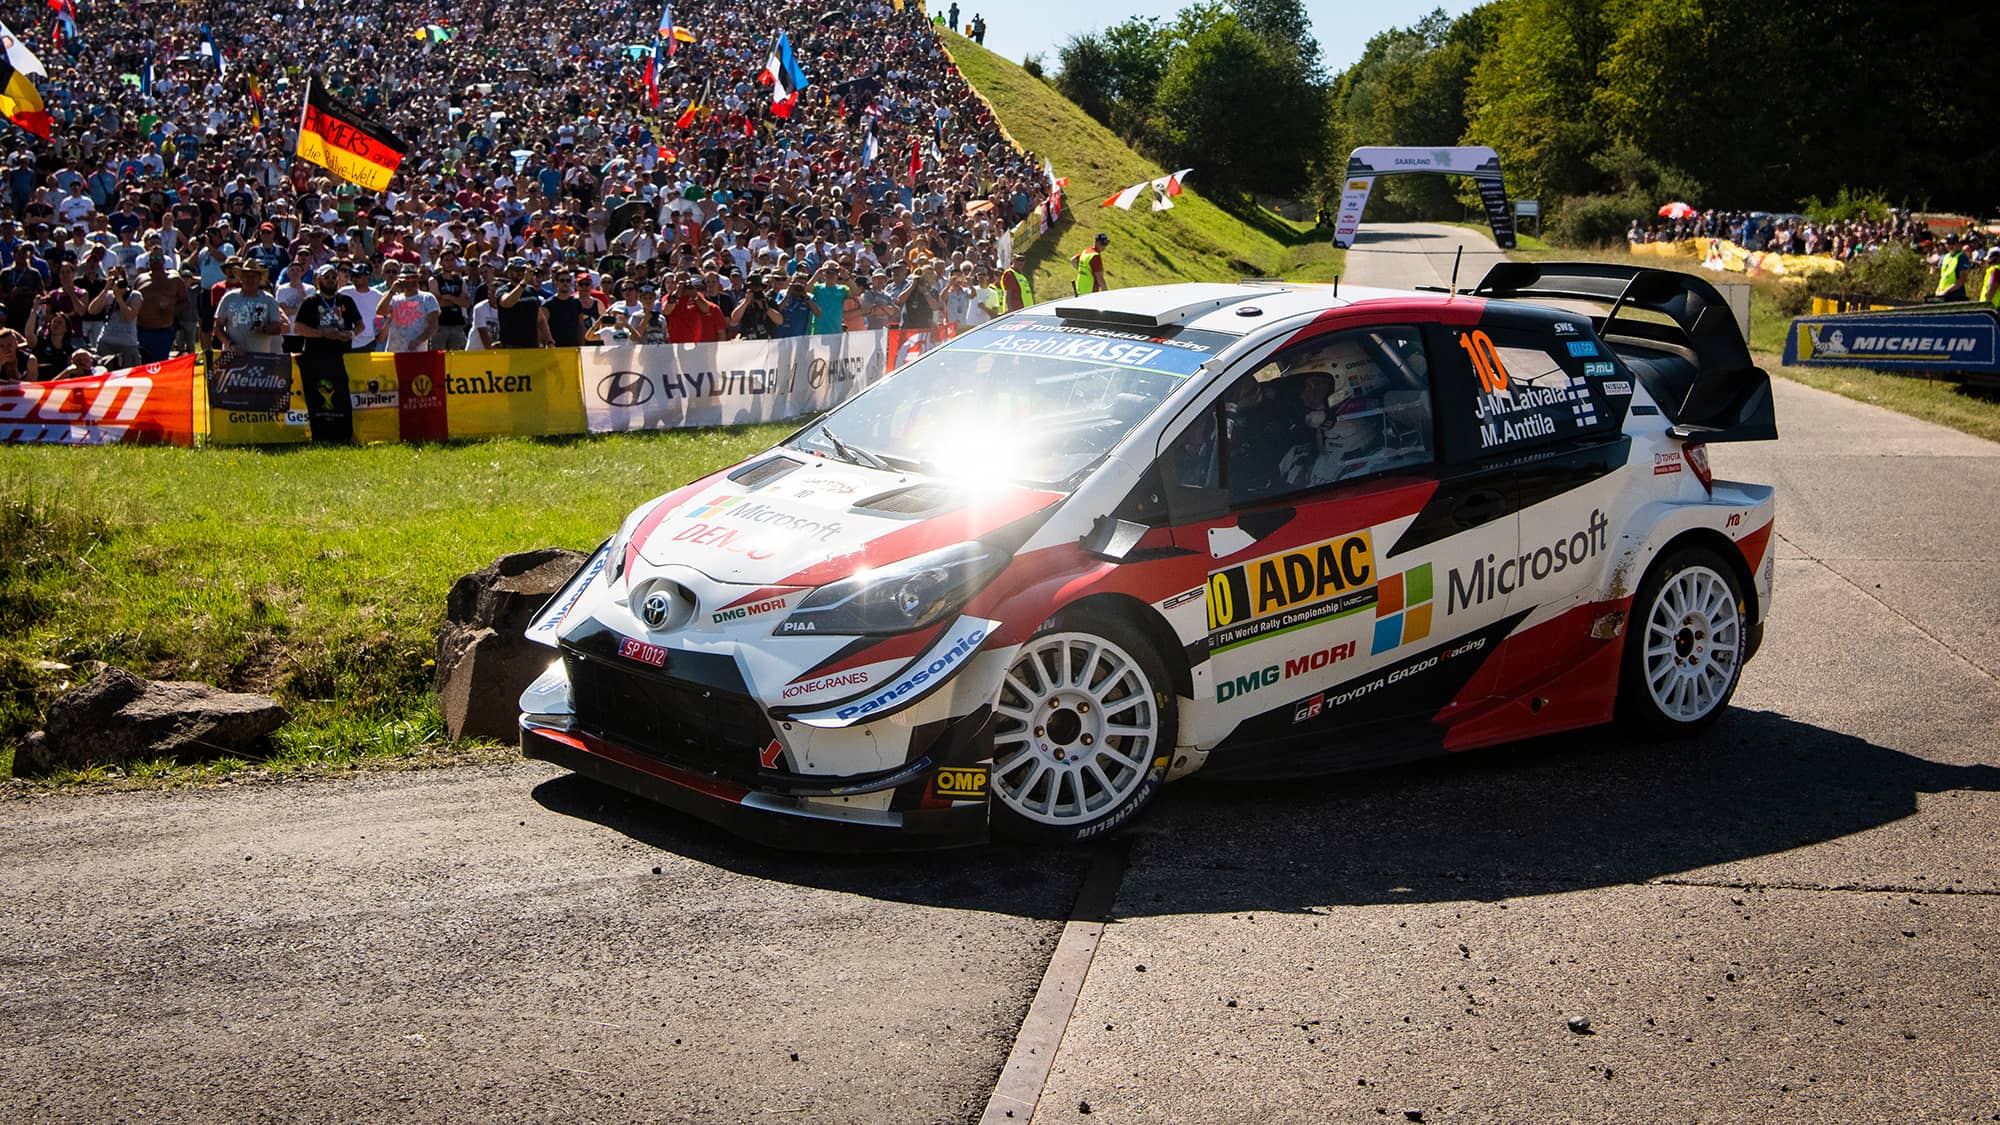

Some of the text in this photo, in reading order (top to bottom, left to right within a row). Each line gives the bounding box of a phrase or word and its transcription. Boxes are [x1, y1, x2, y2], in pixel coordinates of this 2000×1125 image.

[1394, 158, 1431, 166] SAARLAND
[1148, 336, 1210, 352] Racing
[1459, 330, 1508, 393] 10
[1852, 337, 1977, 352] MICHELIN
[354, 393, 396, 408] Jupiler
[446, 370, 532, 395] tanken
[725, 502, 842, 543] Microsoft
[672, 523, 775, 560] DEN
[1258, 536, 1371, 613] ADAC
[1447, 508, 1608, 616] Microsoft
[712, 598, 786, 624] DMG MORI
[1206, 572, 1233, 630] 10
[784, 621, 816, 632] PIAA
[1220, 633, 1234, 644] FIA
[1234, 623, 1258, 639] World
[1260, 618, 1281, 633] Rally
[1282, 602, 1339, 625] Championship
[625, 641, 665, 665] SP 1012
[782, 671, 869, 700] KONECRANES
[836, 630, 985, 721] Panasonic
[1217, 640, 1356, 704] DMG MORI
[1326, 678, 1385, 709] TOYOTA
[1388, 656, 1438, 685] GAZOO
[1441, 637, 1487, 661] Racing
[937, 771, 987, 791] OMP
[1077, 784, 1151, 840] MICHELIN
